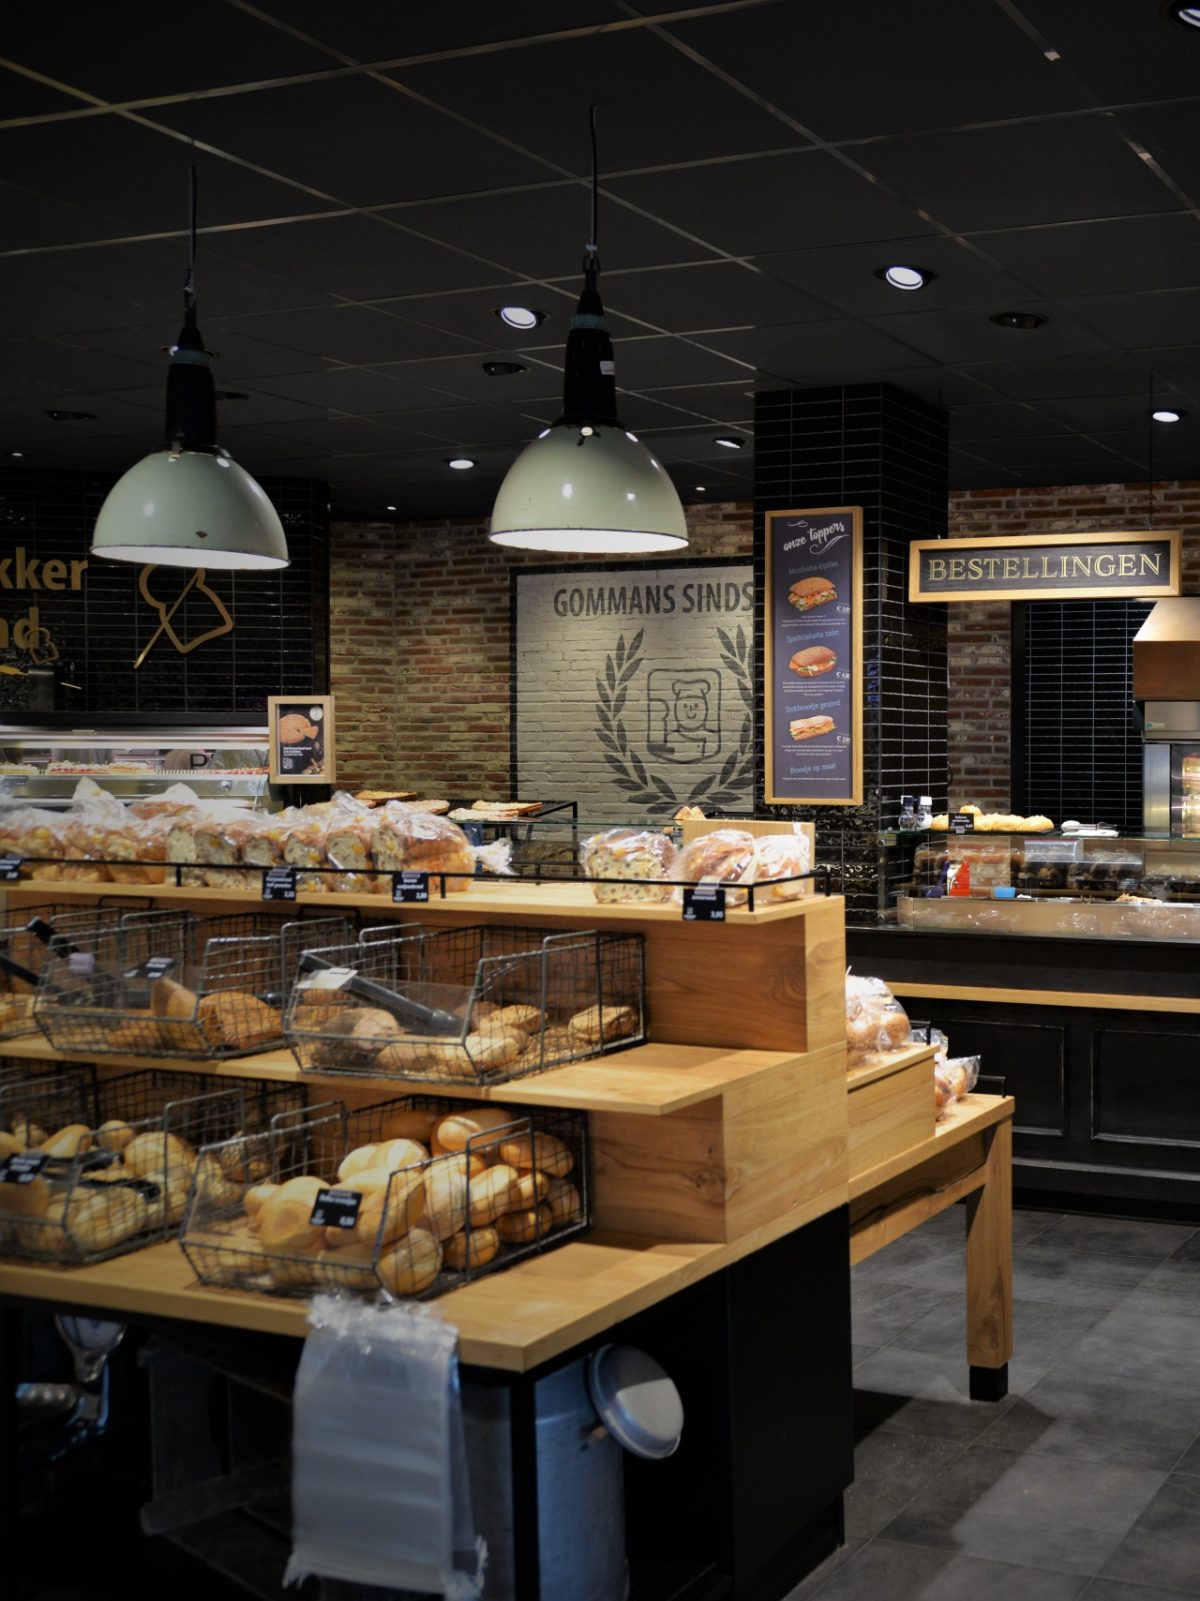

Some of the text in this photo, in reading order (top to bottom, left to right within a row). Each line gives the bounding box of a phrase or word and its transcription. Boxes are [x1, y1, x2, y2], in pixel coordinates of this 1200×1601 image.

[783, 522, 845, 551] onze toppers
[928, 553, 1162, 581] BESTELLINGEN
[553, 581, 754, 617] GOMMANS SINDS
